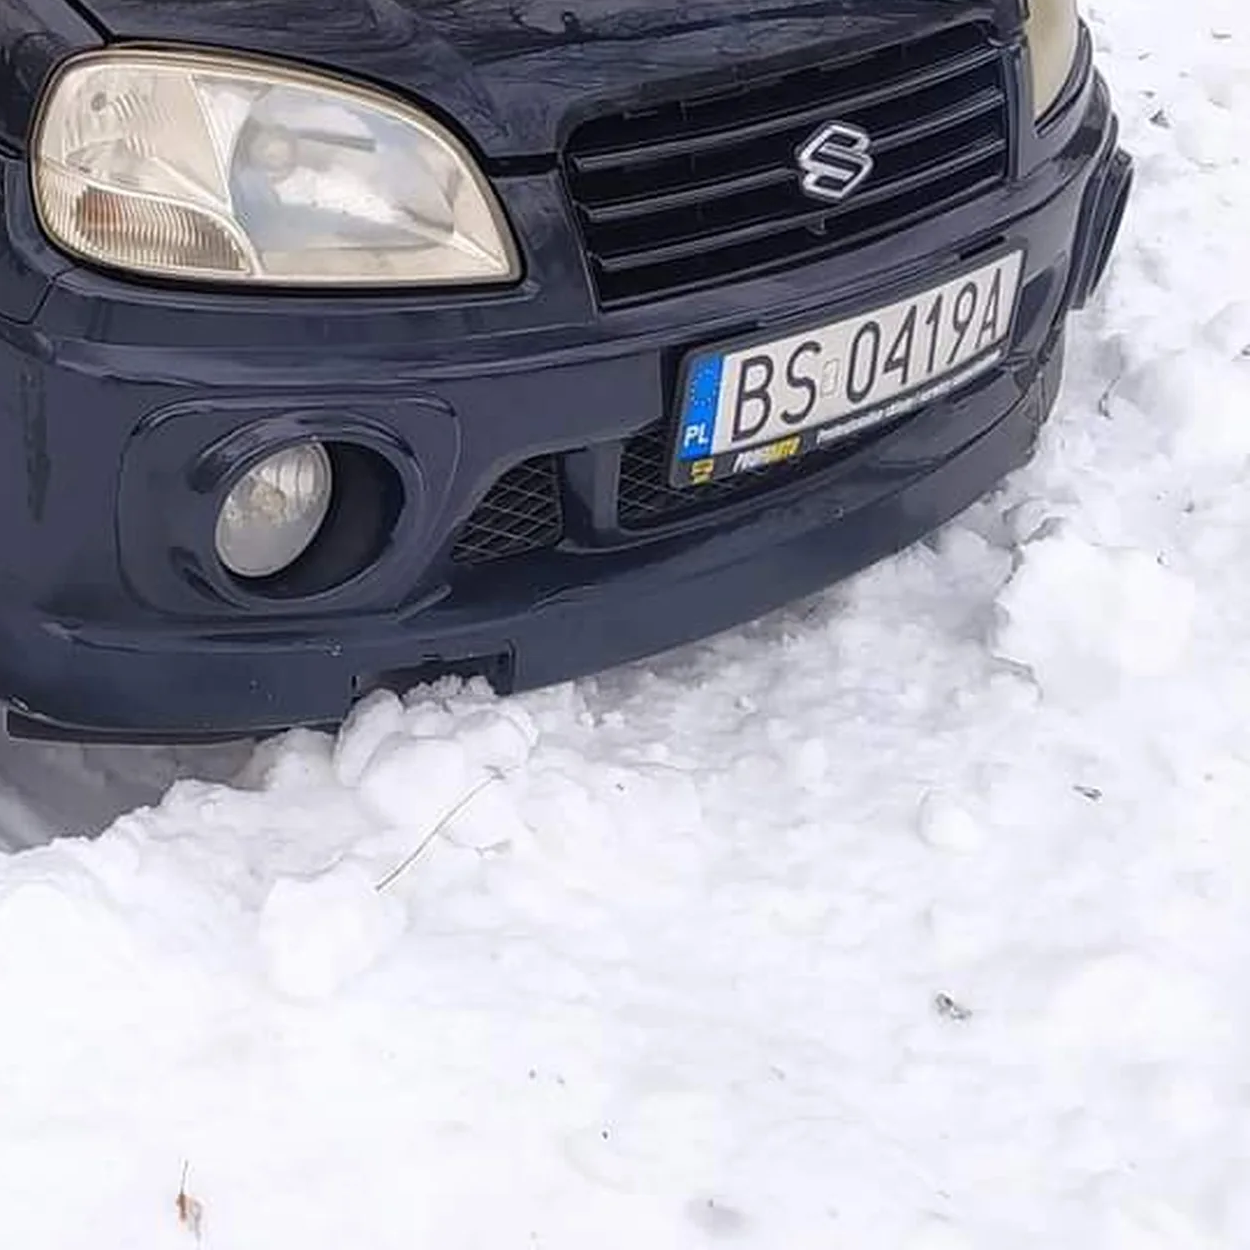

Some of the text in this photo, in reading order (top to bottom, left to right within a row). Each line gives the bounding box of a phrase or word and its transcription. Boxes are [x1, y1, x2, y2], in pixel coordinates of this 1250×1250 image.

[683, 424, 711, 448] PL
[731, 340, 823, 443] BS
[846, 268, 1002, 404] 0419A
